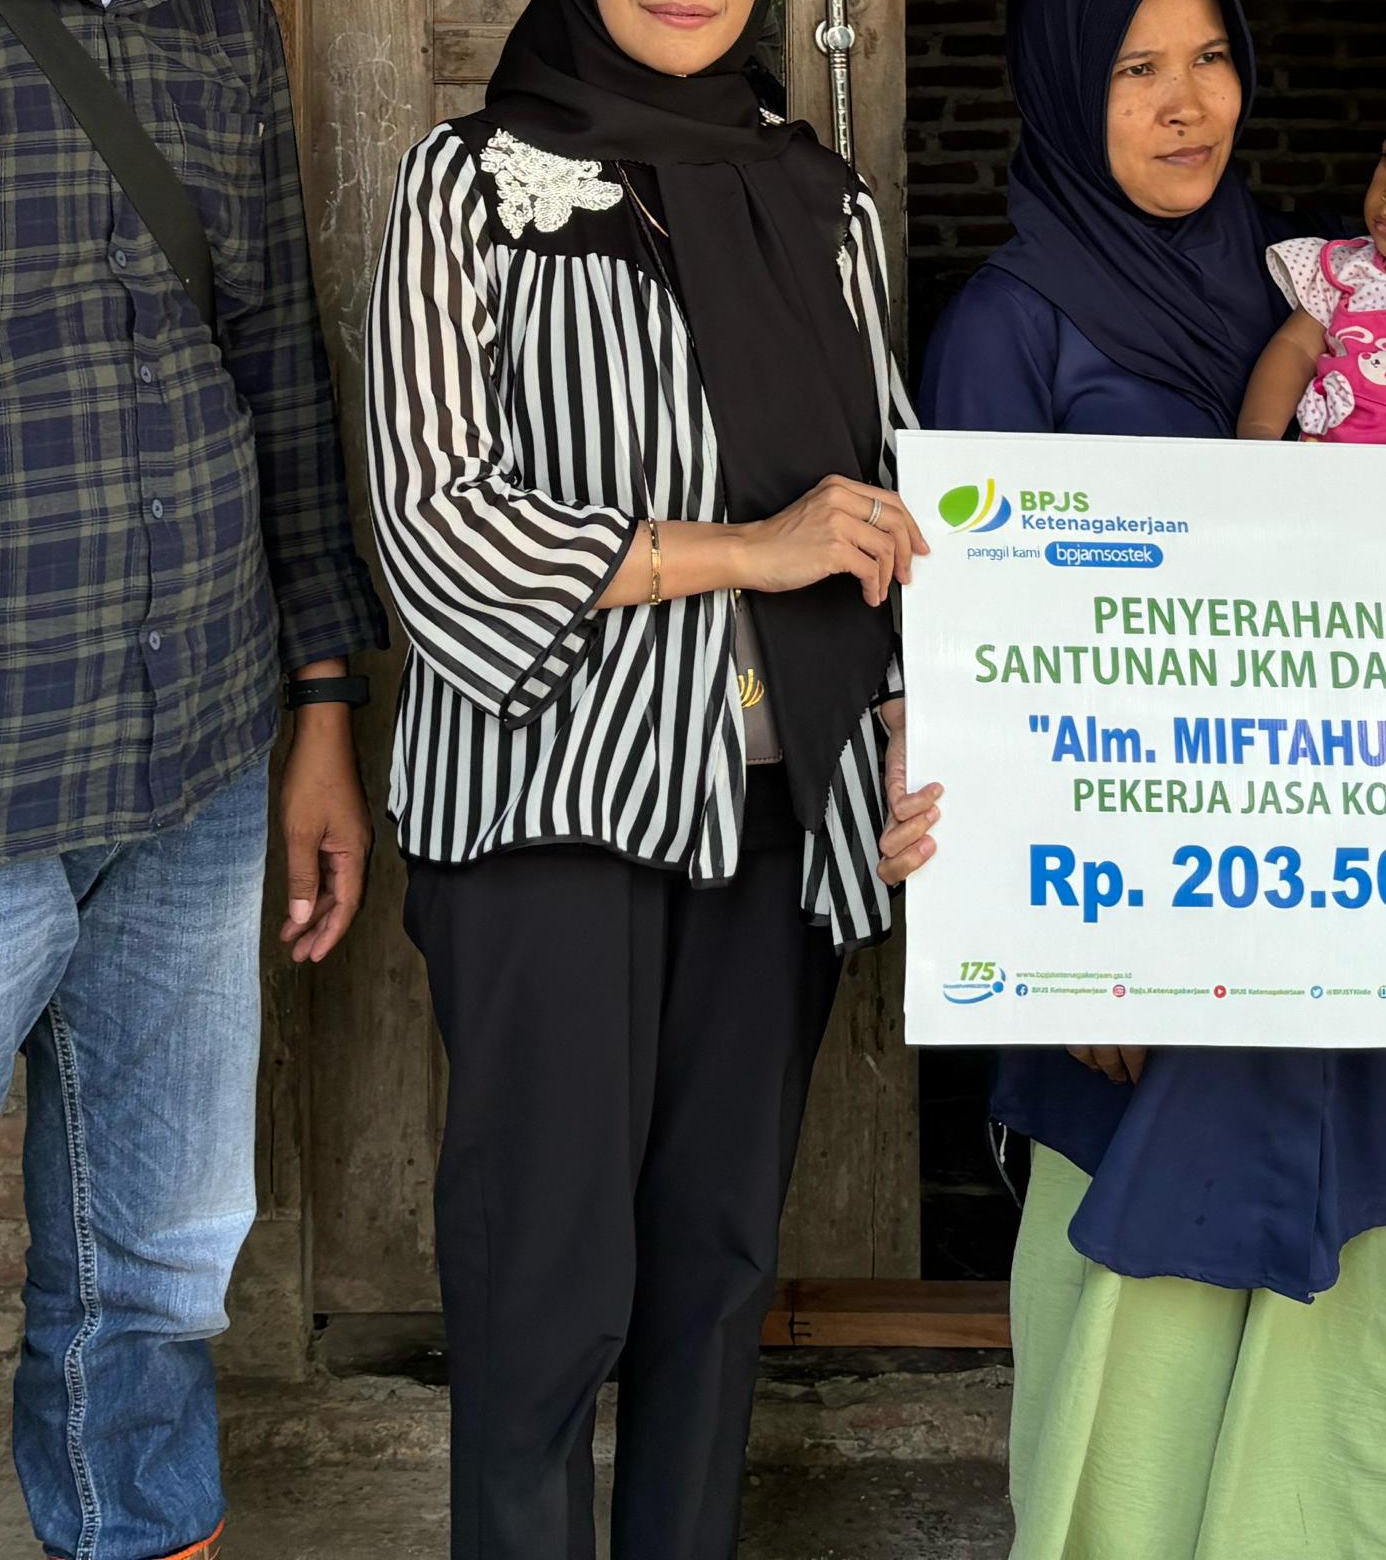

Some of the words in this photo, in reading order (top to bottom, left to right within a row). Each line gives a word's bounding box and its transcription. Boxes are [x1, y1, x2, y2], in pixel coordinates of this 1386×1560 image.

[1020, 491, 1090, 513] BPJS
[1021, 515, 1189, 536] Ketenagakerjaan
[967, 545, 1009, 561] panggil
[1013, 546, 1041, 559] kami
[1056, 544, 1154, 566] bpjamsostek
[1093, 596, 1384, 639] PENYERAHAN
[975, 643, 1214, 687] SANTUNAN
[1229, 648, 1315, 691] JKM
[1028, 714, 1156, 764] "Alm.
[1073, 777, 1232, 814] PEKERJA
[1241, 780, 1334, 816] JASA
[1029, 843, 1145, 923] Rp.
[960, 961, 996, 981] 175
